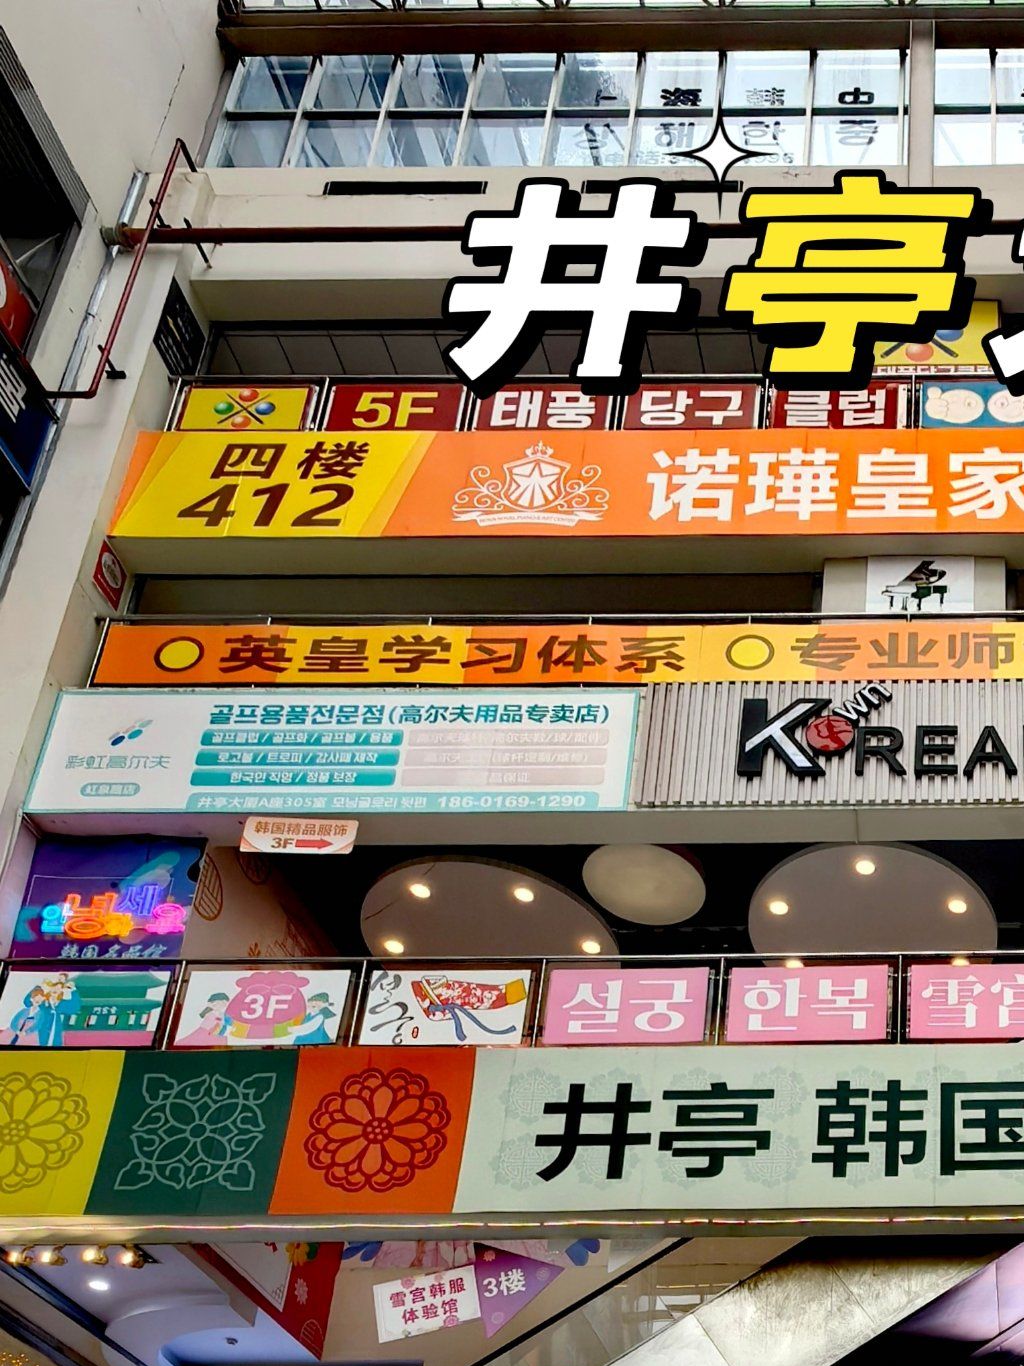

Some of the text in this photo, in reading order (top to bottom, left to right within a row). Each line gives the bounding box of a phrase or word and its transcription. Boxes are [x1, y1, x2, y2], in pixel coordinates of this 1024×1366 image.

[351, 388, 886, 428] 5F 태풍 당구 클럽
[208, 441, 371, 480] 四楼
[176, 483, 358, 529] 412
[219, 634, 686, 675] 英皇学习体系
[65, 755, 171, 770] 彩虹高尔夫
[230, 772, 266, 783] 한국인
[438, 795, 585, 808] 186-0169-1290
[253, 821, 348, 835] 韩国精品服饰
[270, 837, 294, 849] 3F
[240, 993, 293, 1020] 3F
[563, 978, 874, 1033] 설궁 한복
[535, 1082, 774, 1182] 井亭
[389, 1277, 466, 1311] 雪宫韩服
[482, 1267, 528, 1298] 3楼
[401, 1297, 459, 1325] 体验馆
